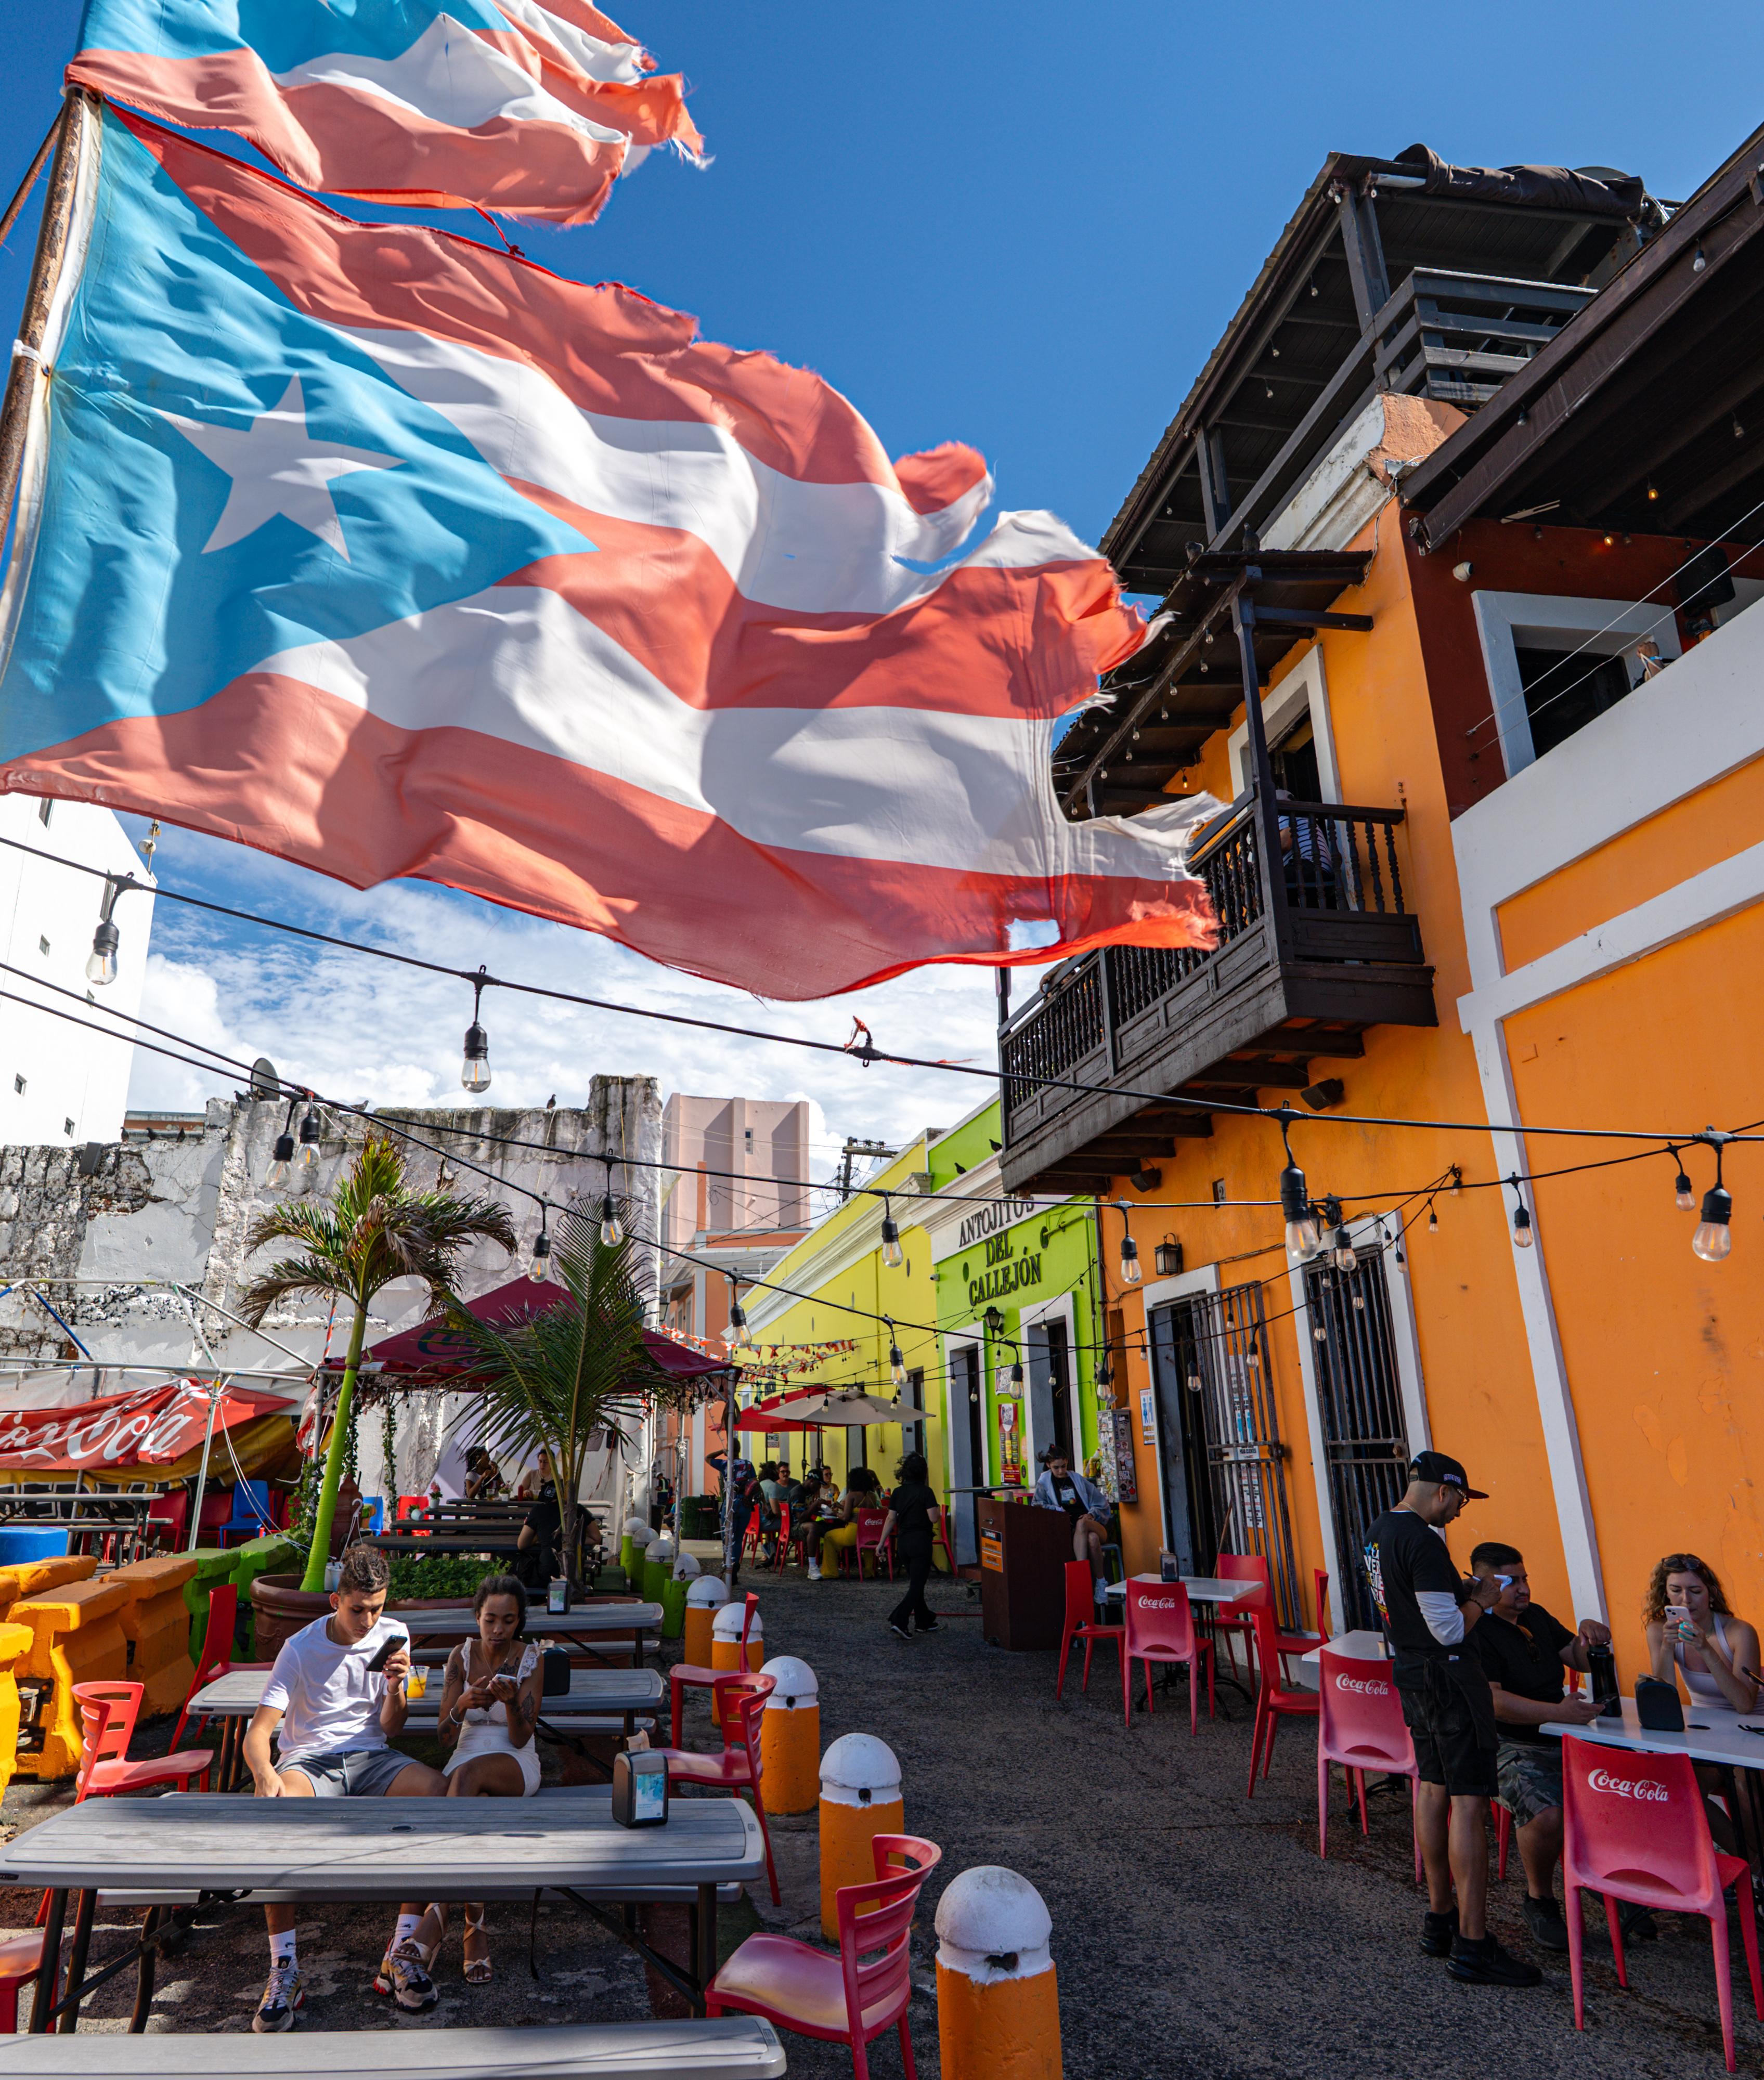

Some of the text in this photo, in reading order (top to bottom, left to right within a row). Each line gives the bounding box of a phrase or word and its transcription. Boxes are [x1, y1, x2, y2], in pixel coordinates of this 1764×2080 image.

[959, 1194, 1034, 1247] ANTOJITOS
[985, 1230, 1014, 1267] DEL
[969, 1246, 1041, 1306] CALLEJÓN
[1138, 1595, 1175, 1609] Coca-Cola
[1336, 1673, 1388, 1695] Coca-Cola
[1588, 1769, 1669, 1801] Coca-Cola
